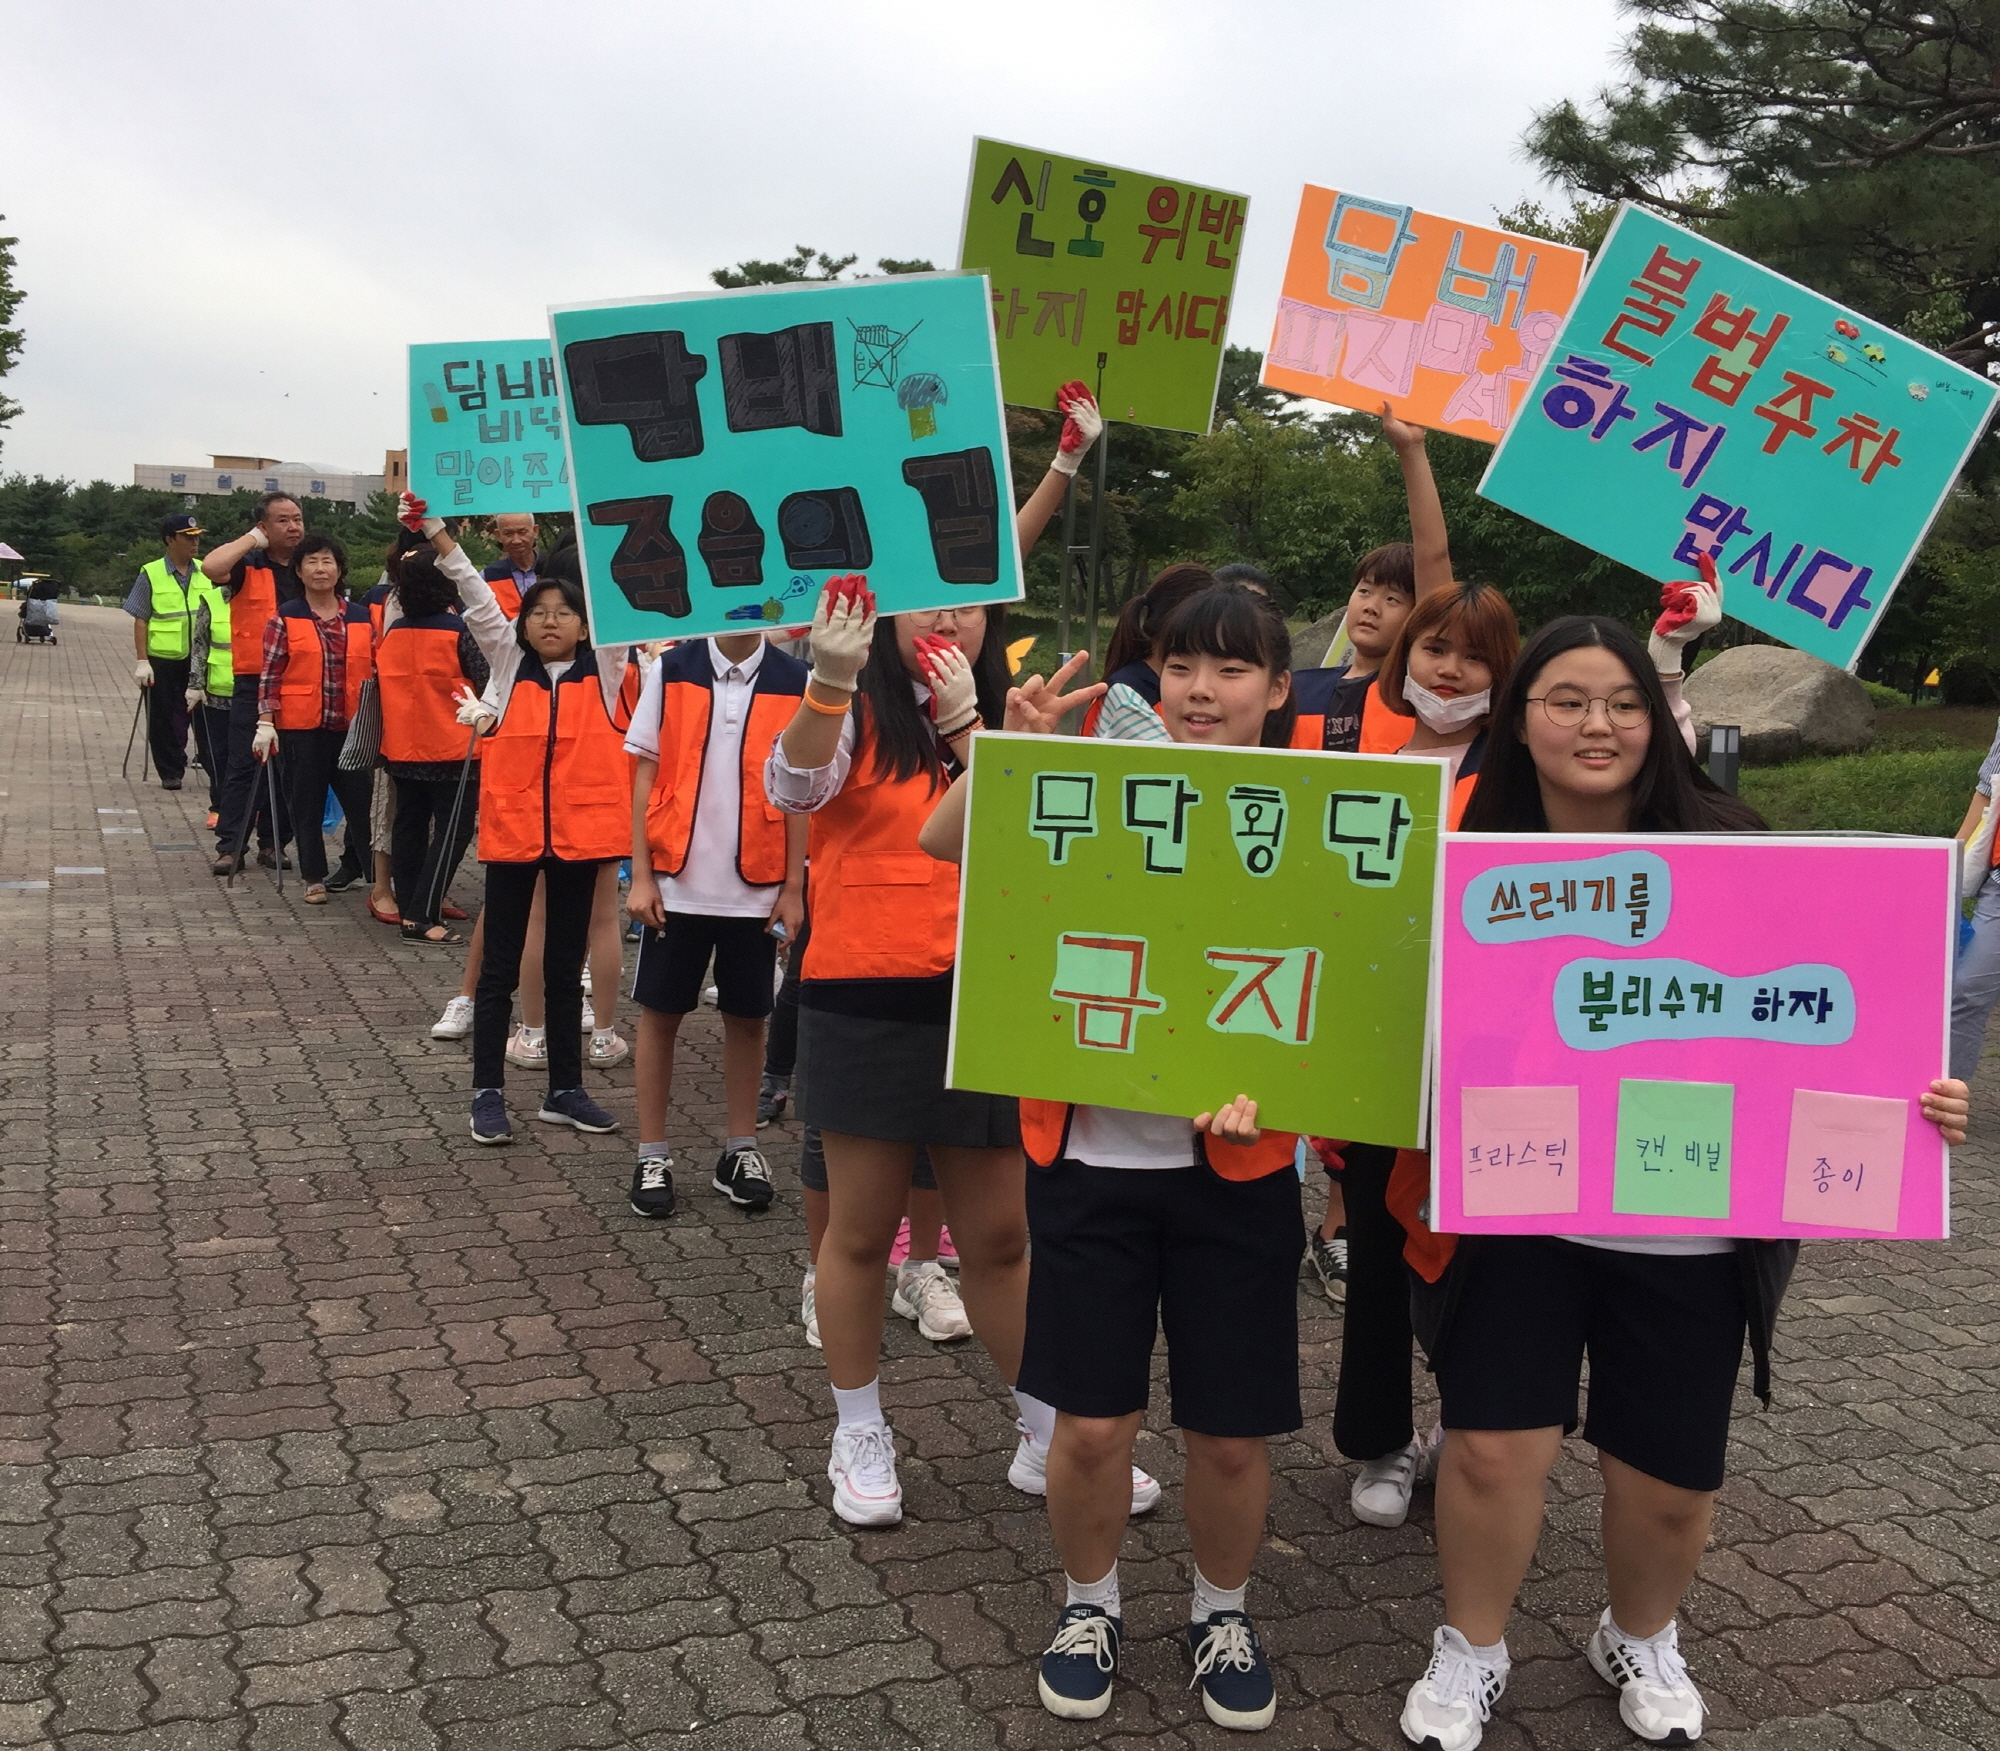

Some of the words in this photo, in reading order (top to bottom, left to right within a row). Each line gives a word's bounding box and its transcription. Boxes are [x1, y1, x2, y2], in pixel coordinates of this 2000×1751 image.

[991, 157, 1116, 258] 신호
[1138, 186, 1244, 269] 위반
[1325, 194, 1538, 330] 담배
[1116, 289, 1229, 346] 맙시다
[1600, 244, 1902, 485] 불법주차
[443, 357, 558, 411] 담배
[564, 322, 844, 462] 담배
[1542, 355, 1727, 489] 하지
[587, 486, 873, 619] 죽음의
[902, 446, 999, 585] 길
[1673, 493, 1873, 630] 맙시다
[1033, 774, 1411, 881] 무단횡단
[1487, 872, 1650, 938] 쓰레기를
[1053, 934, 1323, 1050] 금지
[1579, 971, 1723, 1032] 분리수거
[1751, 987, 1834, 1024] 하자
[1469, 1138, 1568, 1176] 프라스틱
[1812, 1157, 1864, 1194] 종이
